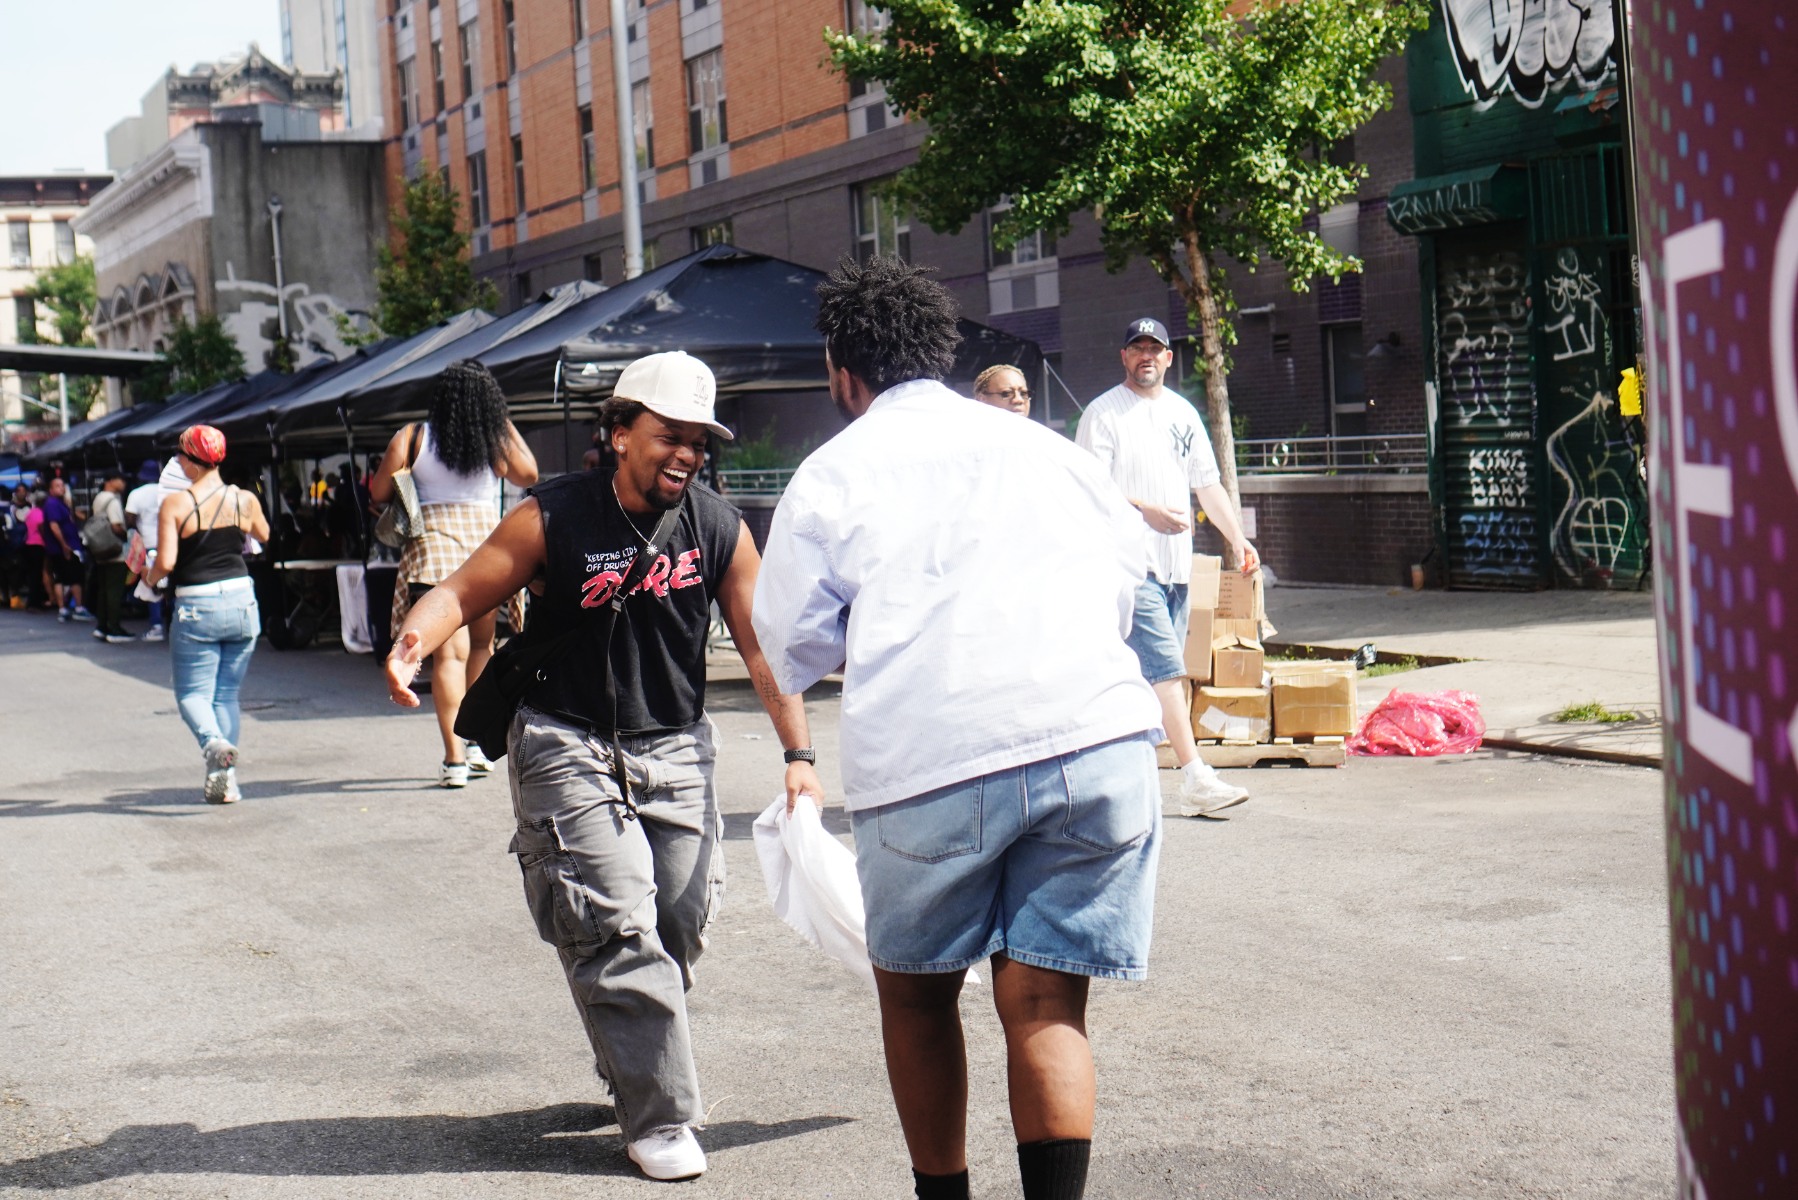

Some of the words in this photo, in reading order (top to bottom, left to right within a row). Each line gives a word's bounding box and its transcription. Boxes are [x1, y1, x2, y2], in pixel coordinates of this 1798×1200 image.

[1139, 320, 1155, 333] NY
[1169, 423, 1194, 458] NY
[622, 545, 638, 558] KIDS
[586, 563, 602, 573] OFF
